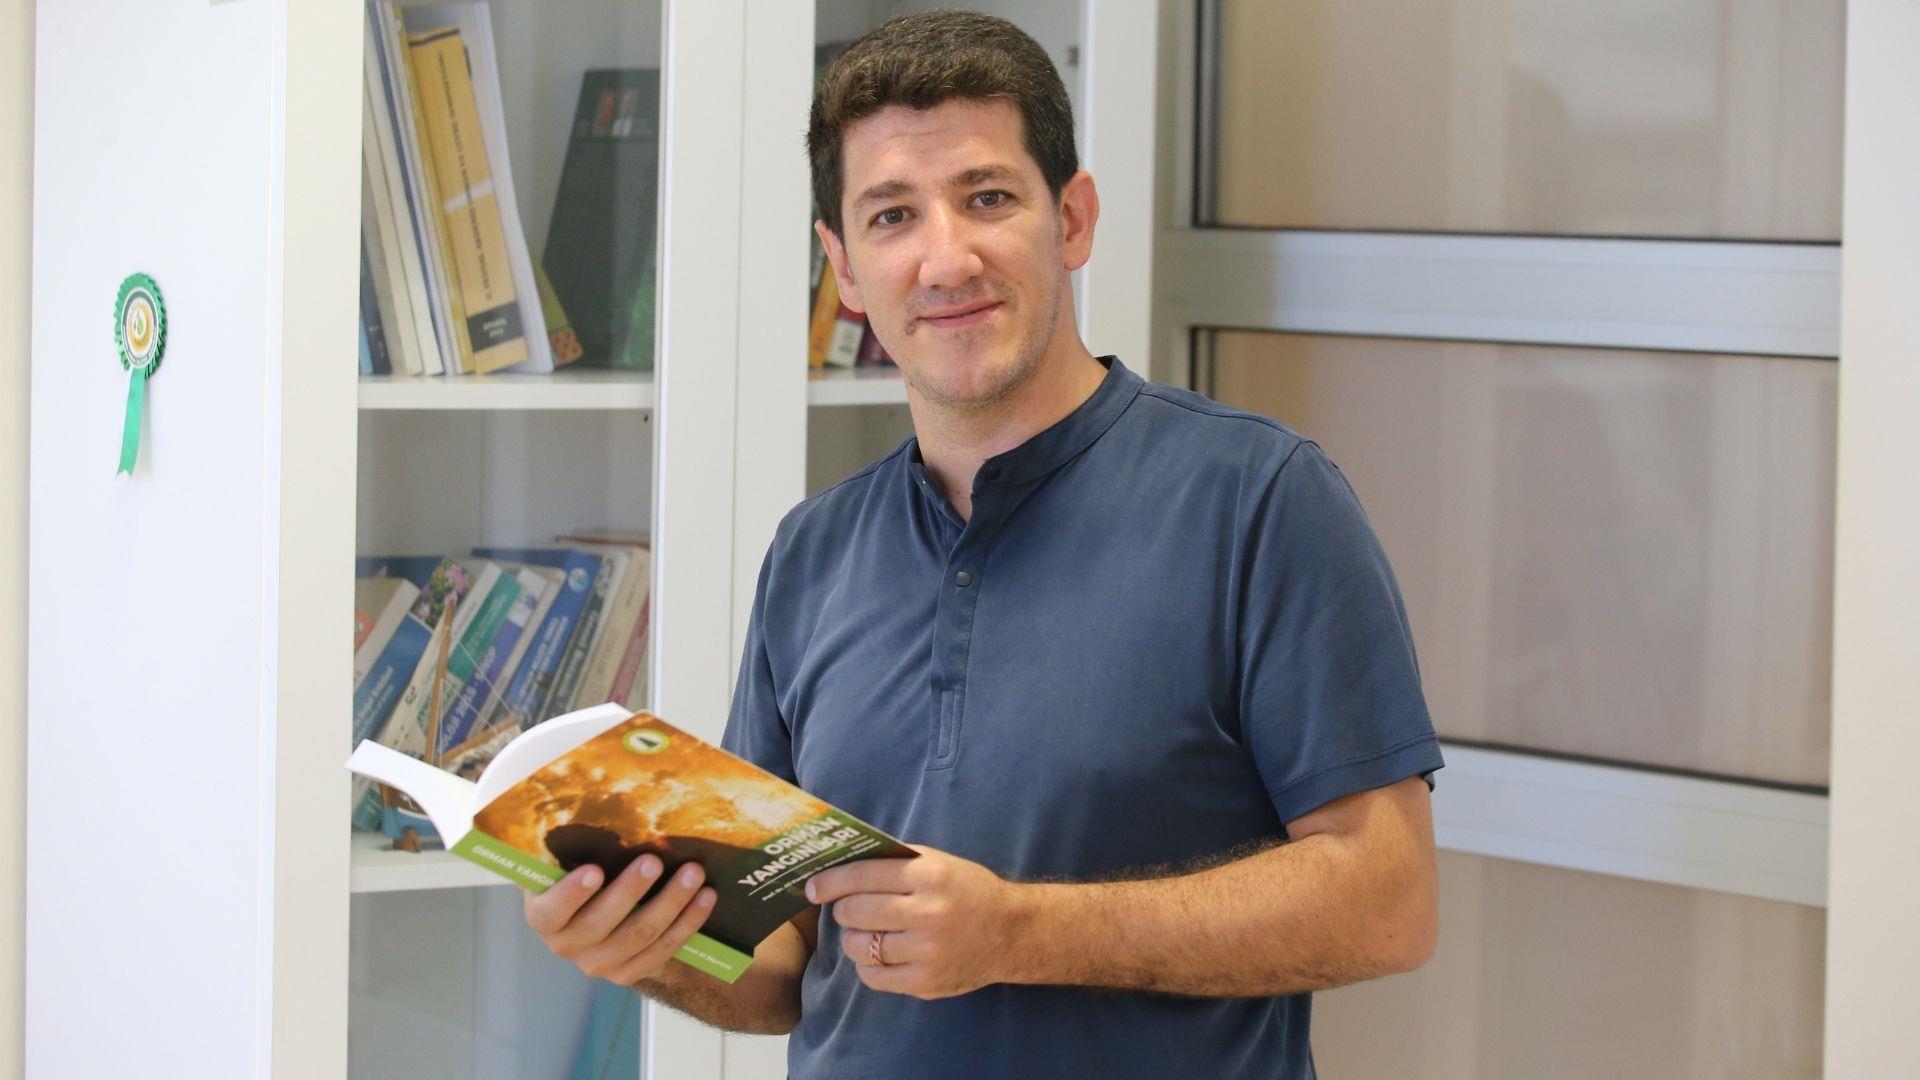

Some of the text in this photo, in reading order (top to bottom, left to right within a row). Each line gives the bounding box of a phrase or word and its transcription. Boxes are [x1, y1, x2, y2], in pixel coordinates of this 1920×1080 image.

[763, 817, 842, 855] ORMAN
[472, 845, 517, 869] ORMAN
[737, 826, 861, 887] YANGINLARI
